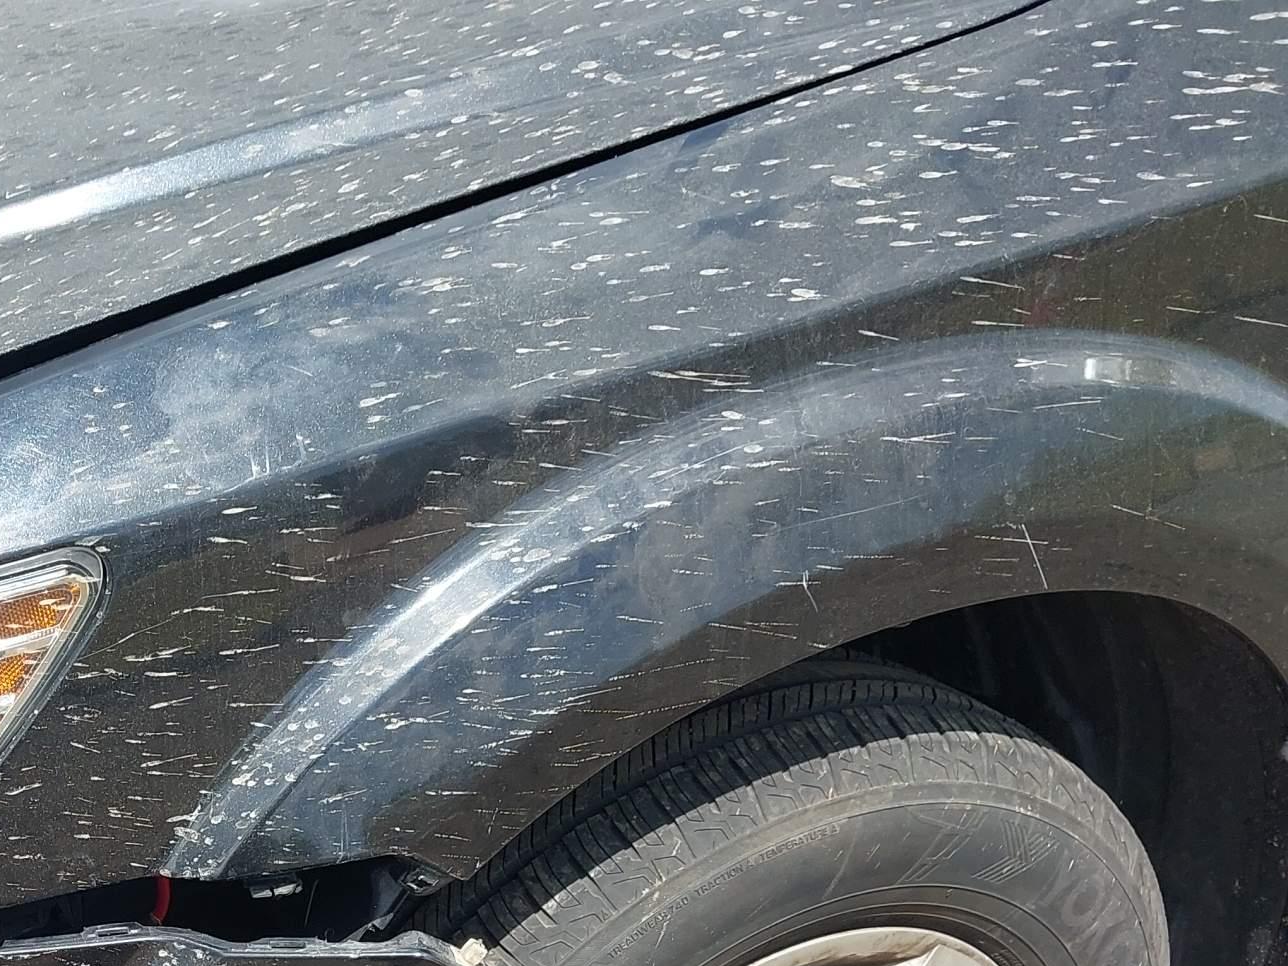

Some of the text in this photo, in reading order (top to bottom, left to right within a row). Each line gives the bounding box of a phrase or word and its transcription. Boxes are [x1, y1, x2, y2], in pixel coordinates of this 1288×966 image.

[608, 911, 670, 959] TREADWEAR
[694, 864, 744, 897] TRACTION
[760, 829, 829, 862] TEMPERATURE
[831, 825, 840, 835] A
